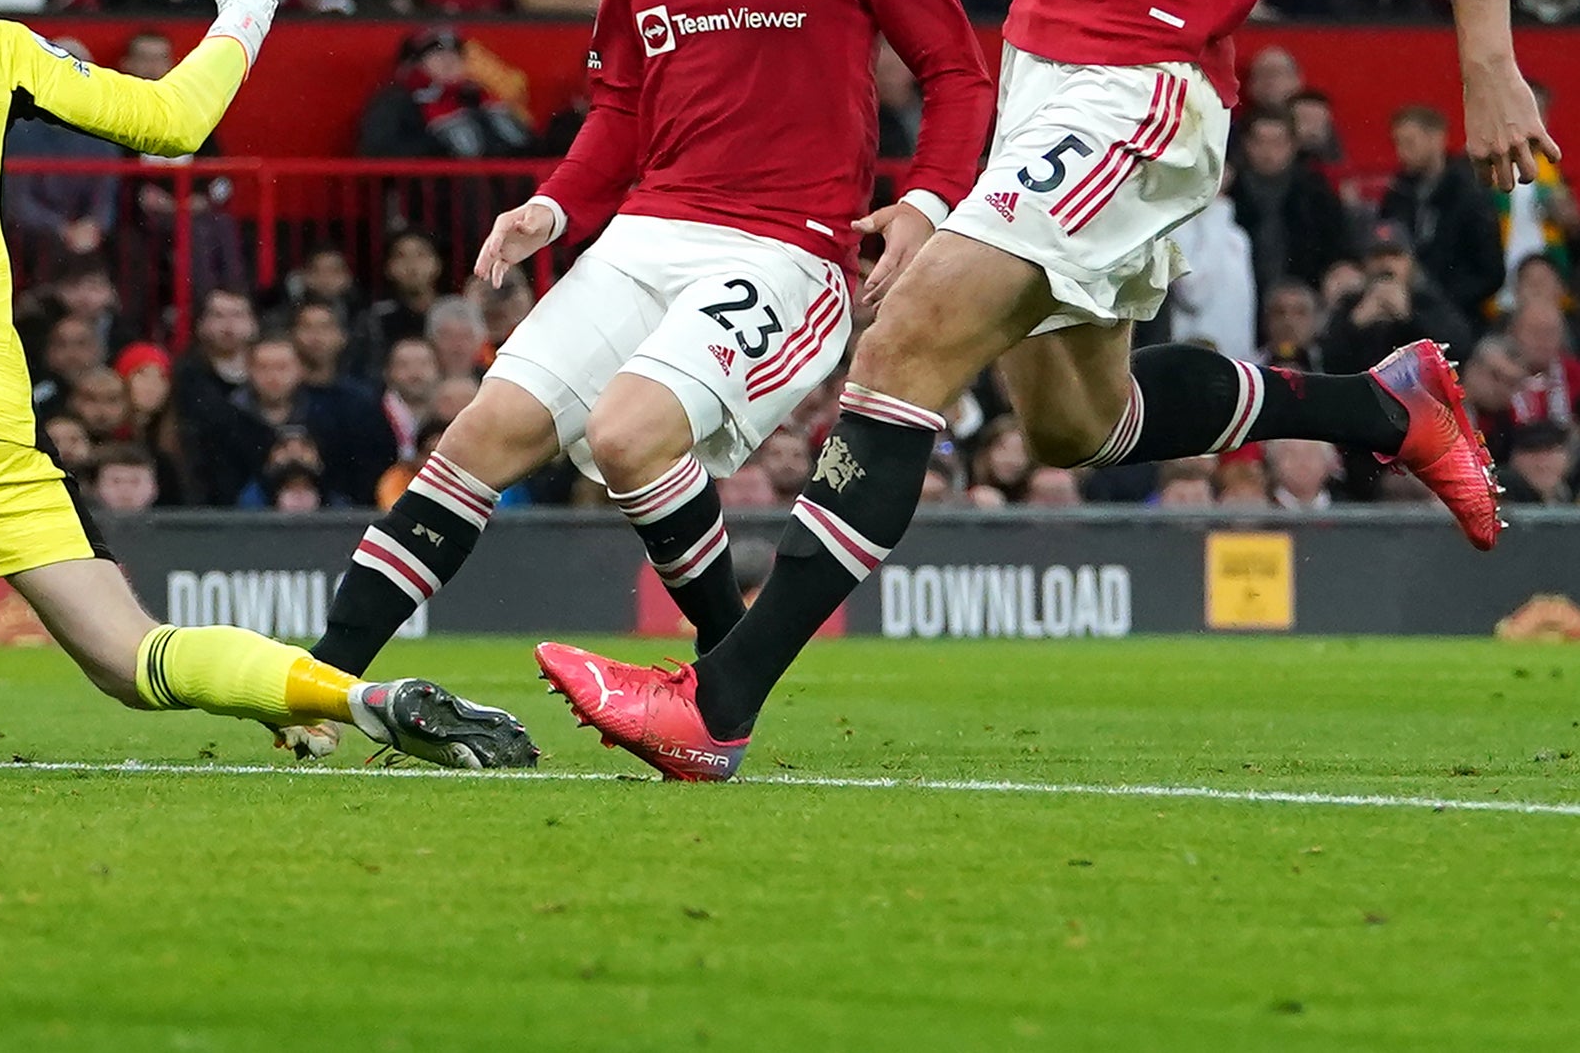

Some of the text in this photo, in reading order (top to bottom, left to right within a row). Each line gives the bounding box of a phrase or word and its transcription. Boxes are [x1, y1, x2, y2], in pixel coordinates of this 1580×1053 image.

[671, 7, 808, 36] TeamViewer
[1017, 133, 1095, 194] 5
[984, 194, 1016, 224] adidas
[698, 278, 784, 359] 23
[880, 564, 1132, 639] DOWNLOAD
[658, 743, 731, 769] ULTRA
